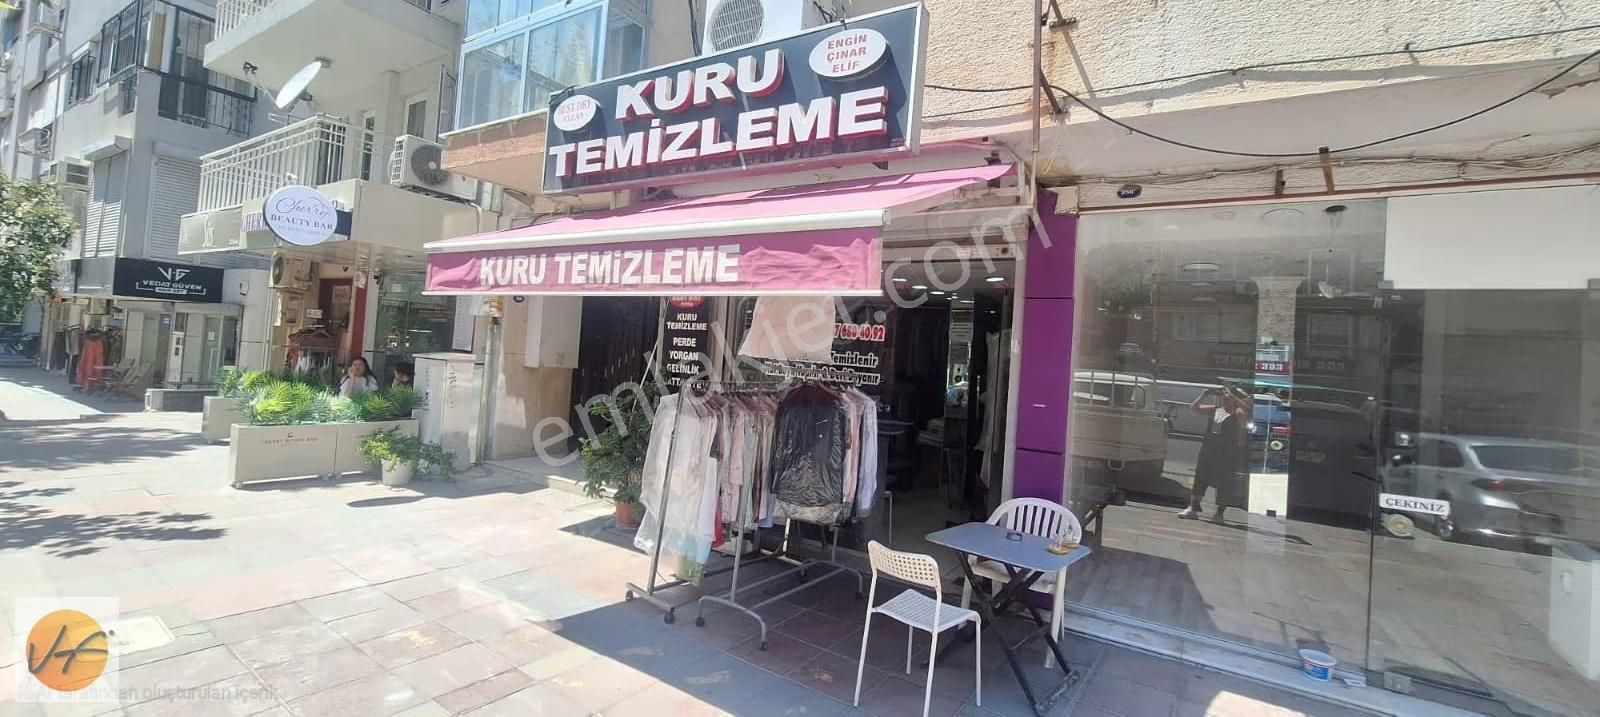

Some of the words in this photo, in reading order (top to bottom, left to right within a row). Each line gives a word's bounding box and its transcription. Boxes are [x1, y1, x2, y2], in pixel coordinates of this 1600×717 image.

[827, 33, 868, 50] ENGİN
[826, 46, 867, 63] ÇINAR
[832, 59, 861, 73] ELİF
[615, 49, 783, 121] KURU
[549, 86, 888, 178] TEMİZLEME
[270, 213, 310, 227] BEAUTY
[311, 221, 334, 231] BAR
[479, 253, 547, 286] KURU
[142, 279, 171, 289] VEDAT
[676, 313, 698, 321] KURU
[666, 321, 708, 331] TEMİZLEME
[870, 324, 886, 341] 92
[673, 337, 697, 347] PERDE
[669, 350, 699, 361] YORGAN
[666, 363, 700, 375] GELİNLİK
